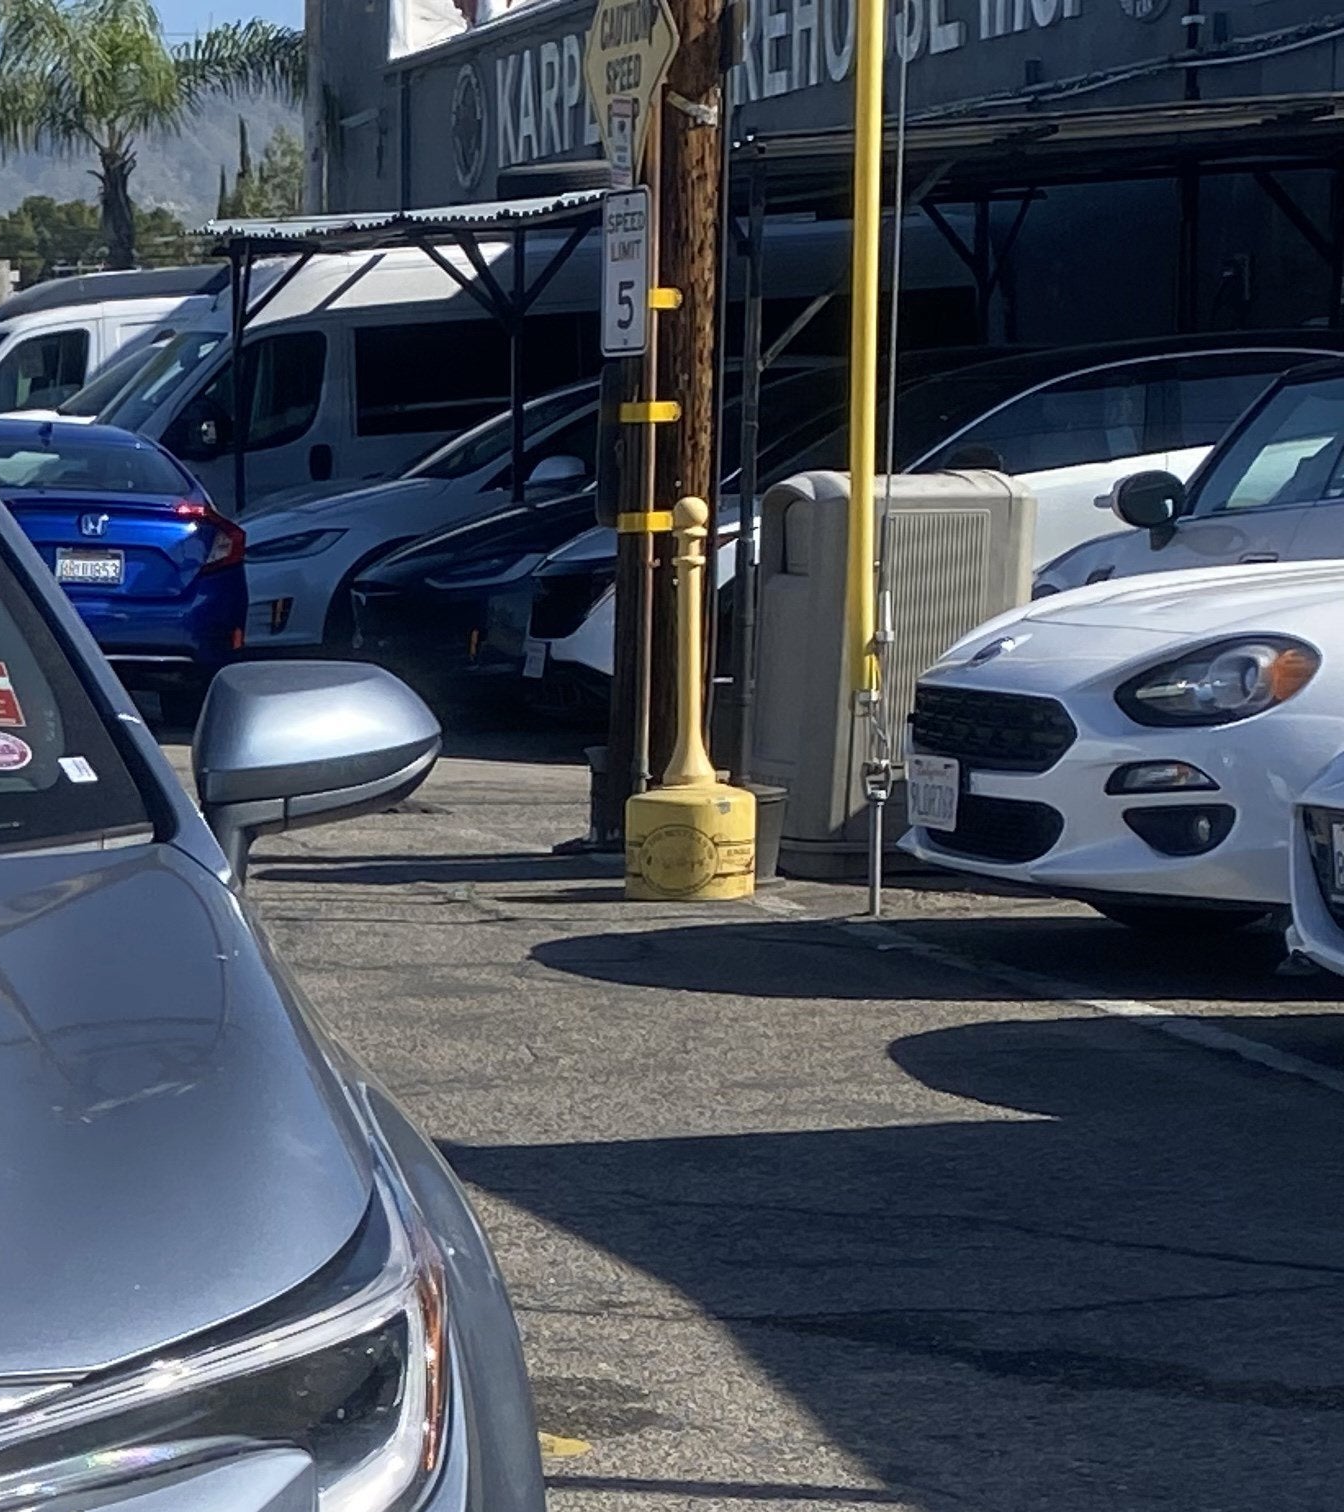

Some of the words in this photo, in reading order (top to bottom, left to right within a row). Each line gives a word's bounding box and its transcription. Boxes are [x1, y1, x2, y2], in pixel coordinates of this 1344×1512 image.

[606, 53, 643, 95] SPEED
[607, 212, 645, 234] SPEED
[610, 238, 642, 263] LIMIT
[617, 280, 635, 330] 5
